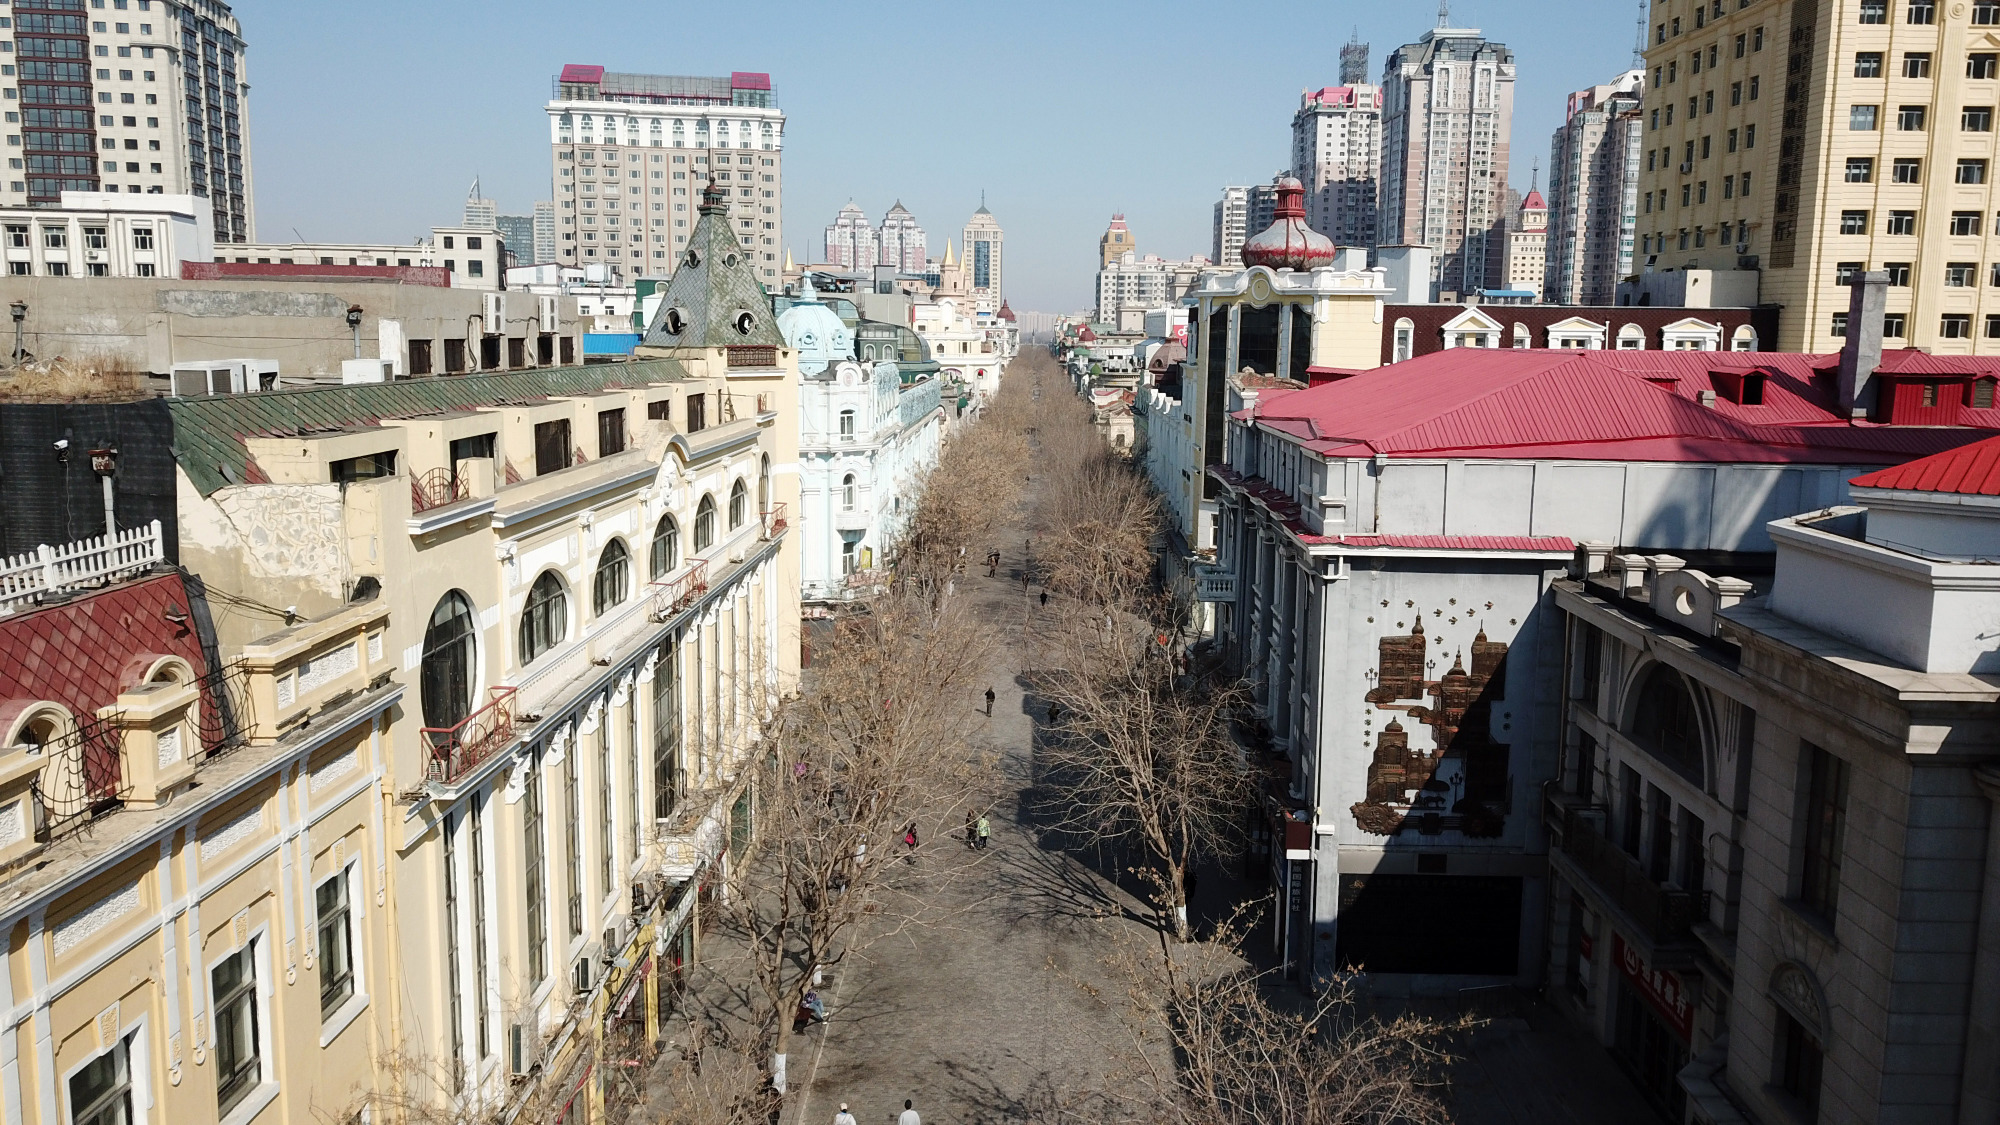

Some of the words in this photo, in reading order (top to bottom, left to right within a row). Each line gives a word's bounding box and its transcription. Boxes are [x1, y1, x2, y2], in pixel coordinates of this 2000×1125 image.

[1775, 26, 1801, 241] 中国邮政储蓄银行
